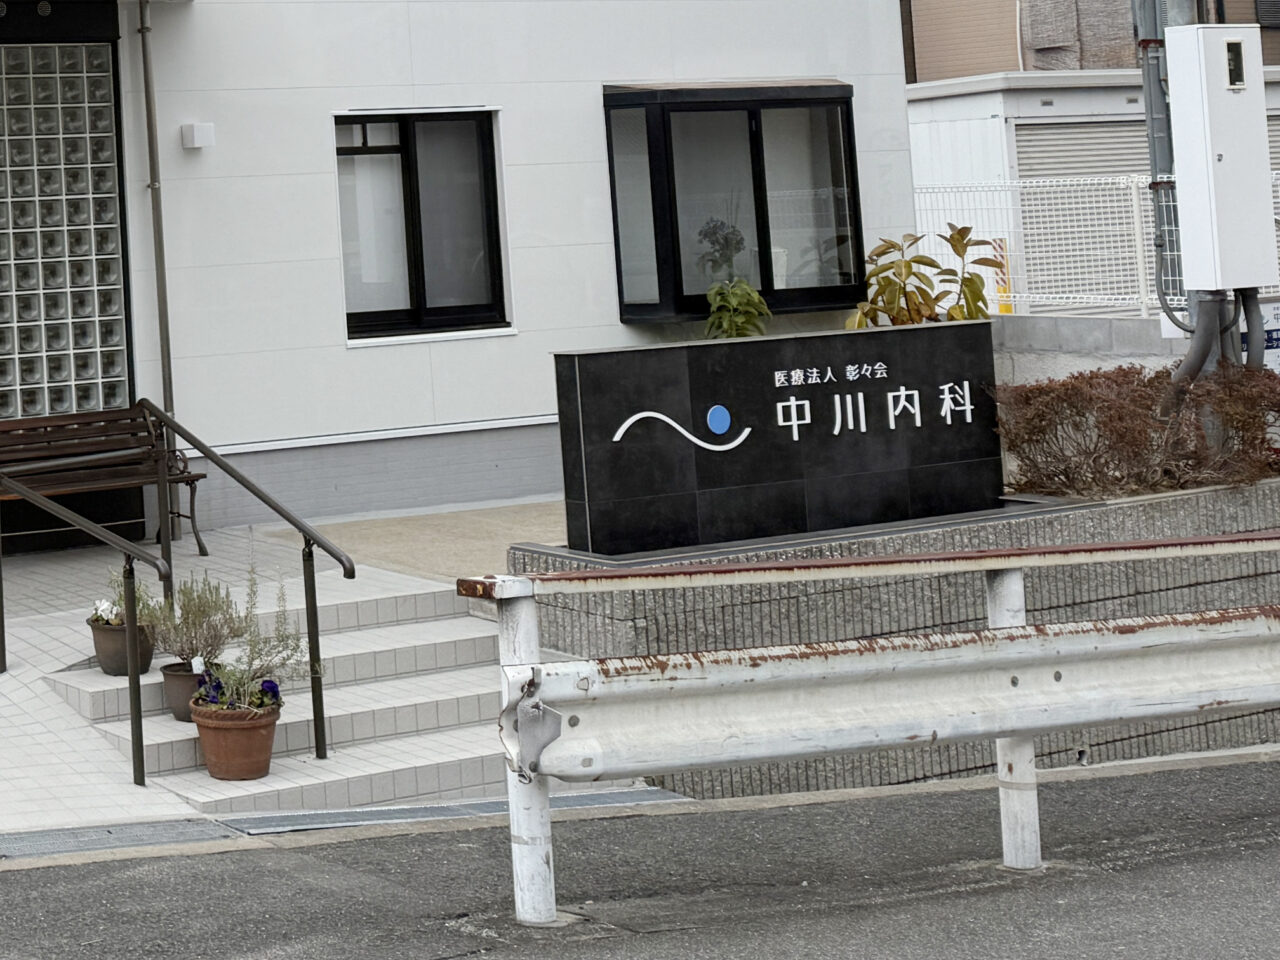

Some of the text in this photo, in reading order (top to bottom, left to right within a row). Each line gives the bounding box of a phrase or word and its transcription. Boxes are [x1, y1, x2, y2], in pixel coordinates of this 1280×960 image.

[774, 361, 889, 388] 医療法人 彰々会
[776, 380, 975, 442] 中川内科
